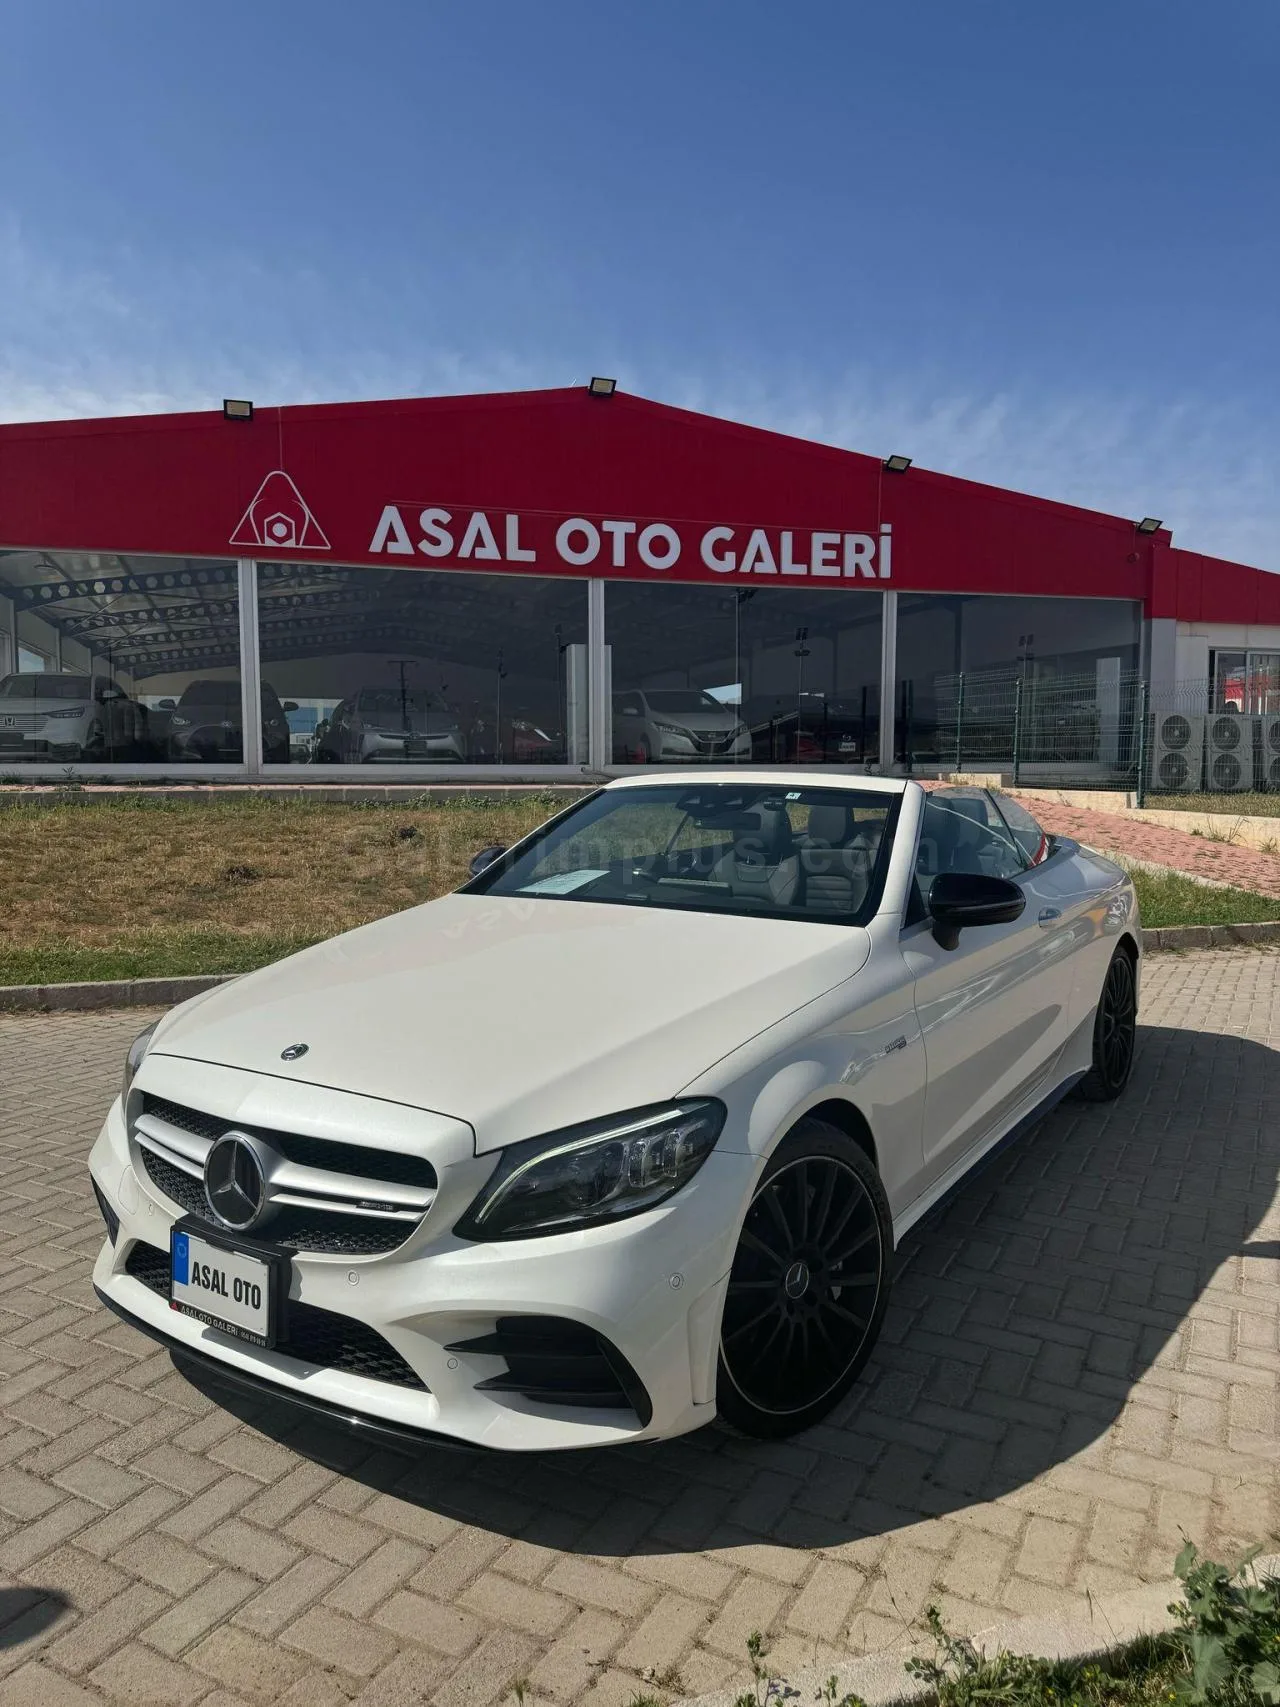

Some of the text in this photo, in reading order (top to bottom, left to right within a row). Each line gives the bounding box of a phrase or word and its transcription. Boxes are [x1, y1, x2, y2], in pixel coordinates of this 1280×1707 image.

[368, 504, 893, 579] ASAL OTO GALERİ
[191, 1261, 261, 1309] ASAL OTO
[180, 1305, 198, 1319] ASAL
[198, 1313, 212, 1325] OTO
